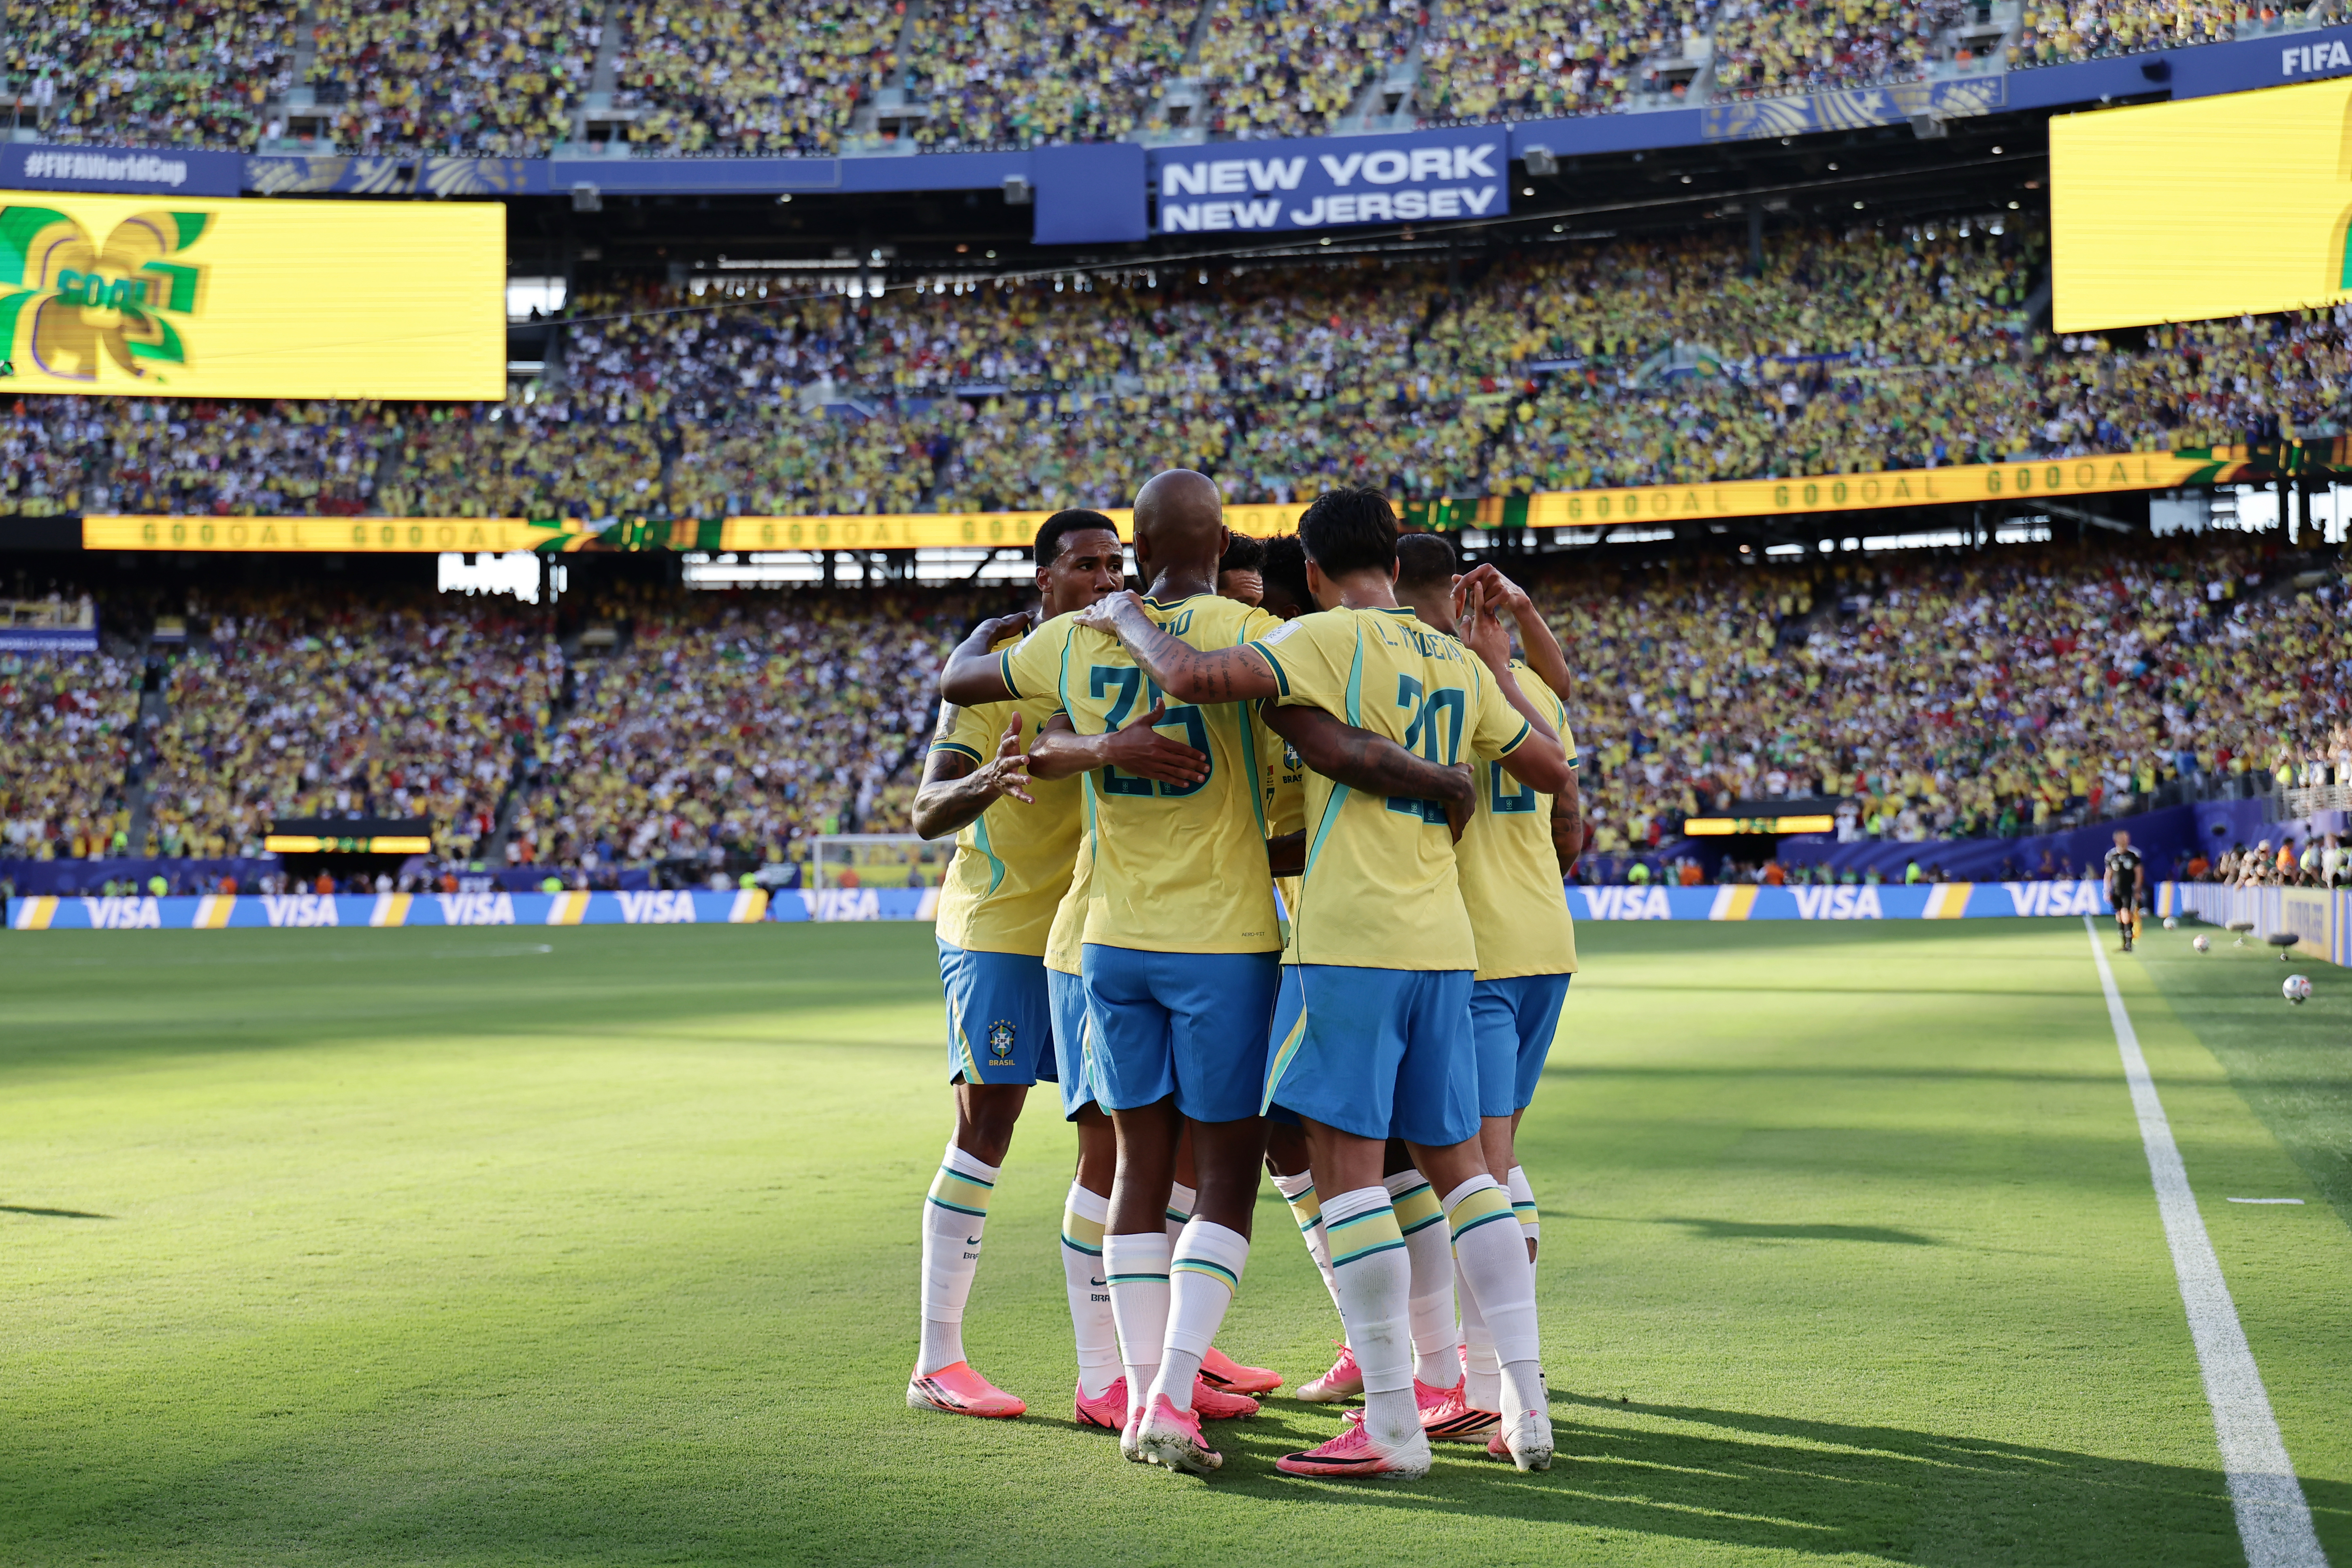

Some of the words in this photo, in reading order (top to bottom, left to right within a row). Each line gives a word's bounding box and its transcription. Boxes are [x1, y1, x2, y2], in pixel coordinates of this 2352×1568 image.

[2282, 40, 2352, 76] FIFA
[23, 151, 187, 187] #FIFAWorldCup
[1162, 156, 1308, 196] NEW
[1319, 143, 1499, 187] YORK
[1162, 198, 1282, 234] NEW
[1290, 185, 1499, 227] JERSEY
[1774, 475, 1941, 508] GOOOAL
[1985, 458, 2158, 495] GOOOAL
[1568, 488, 1729, 518] GOOOAL
[142, 523, 308, 548] GOOOAL
[351, 525, 512, 549] GOOOAL
[761, 522, 916, 545] GOOOAL
[1374, 621, 1398, 646] L.
[1386, 672, 1466, 826] 20
[1283, 774, 1302, 784] BRAS
[1266, 787, 1275, 820] 7
[83, 896, 162, 929] VISA
[259, 894, 339, 927] VISA
[437, 892, 516, 925] VISA
[616, 890, 697, 923] VISA
[797, 888, 881, 921] VISA
[1577, 885, 1672, 920] VISA
[1786, 884, 1884, 919] VISA
[2002, 880, 2101, 916] VISA
[1091, 1293, 1111, 1302] BRA
